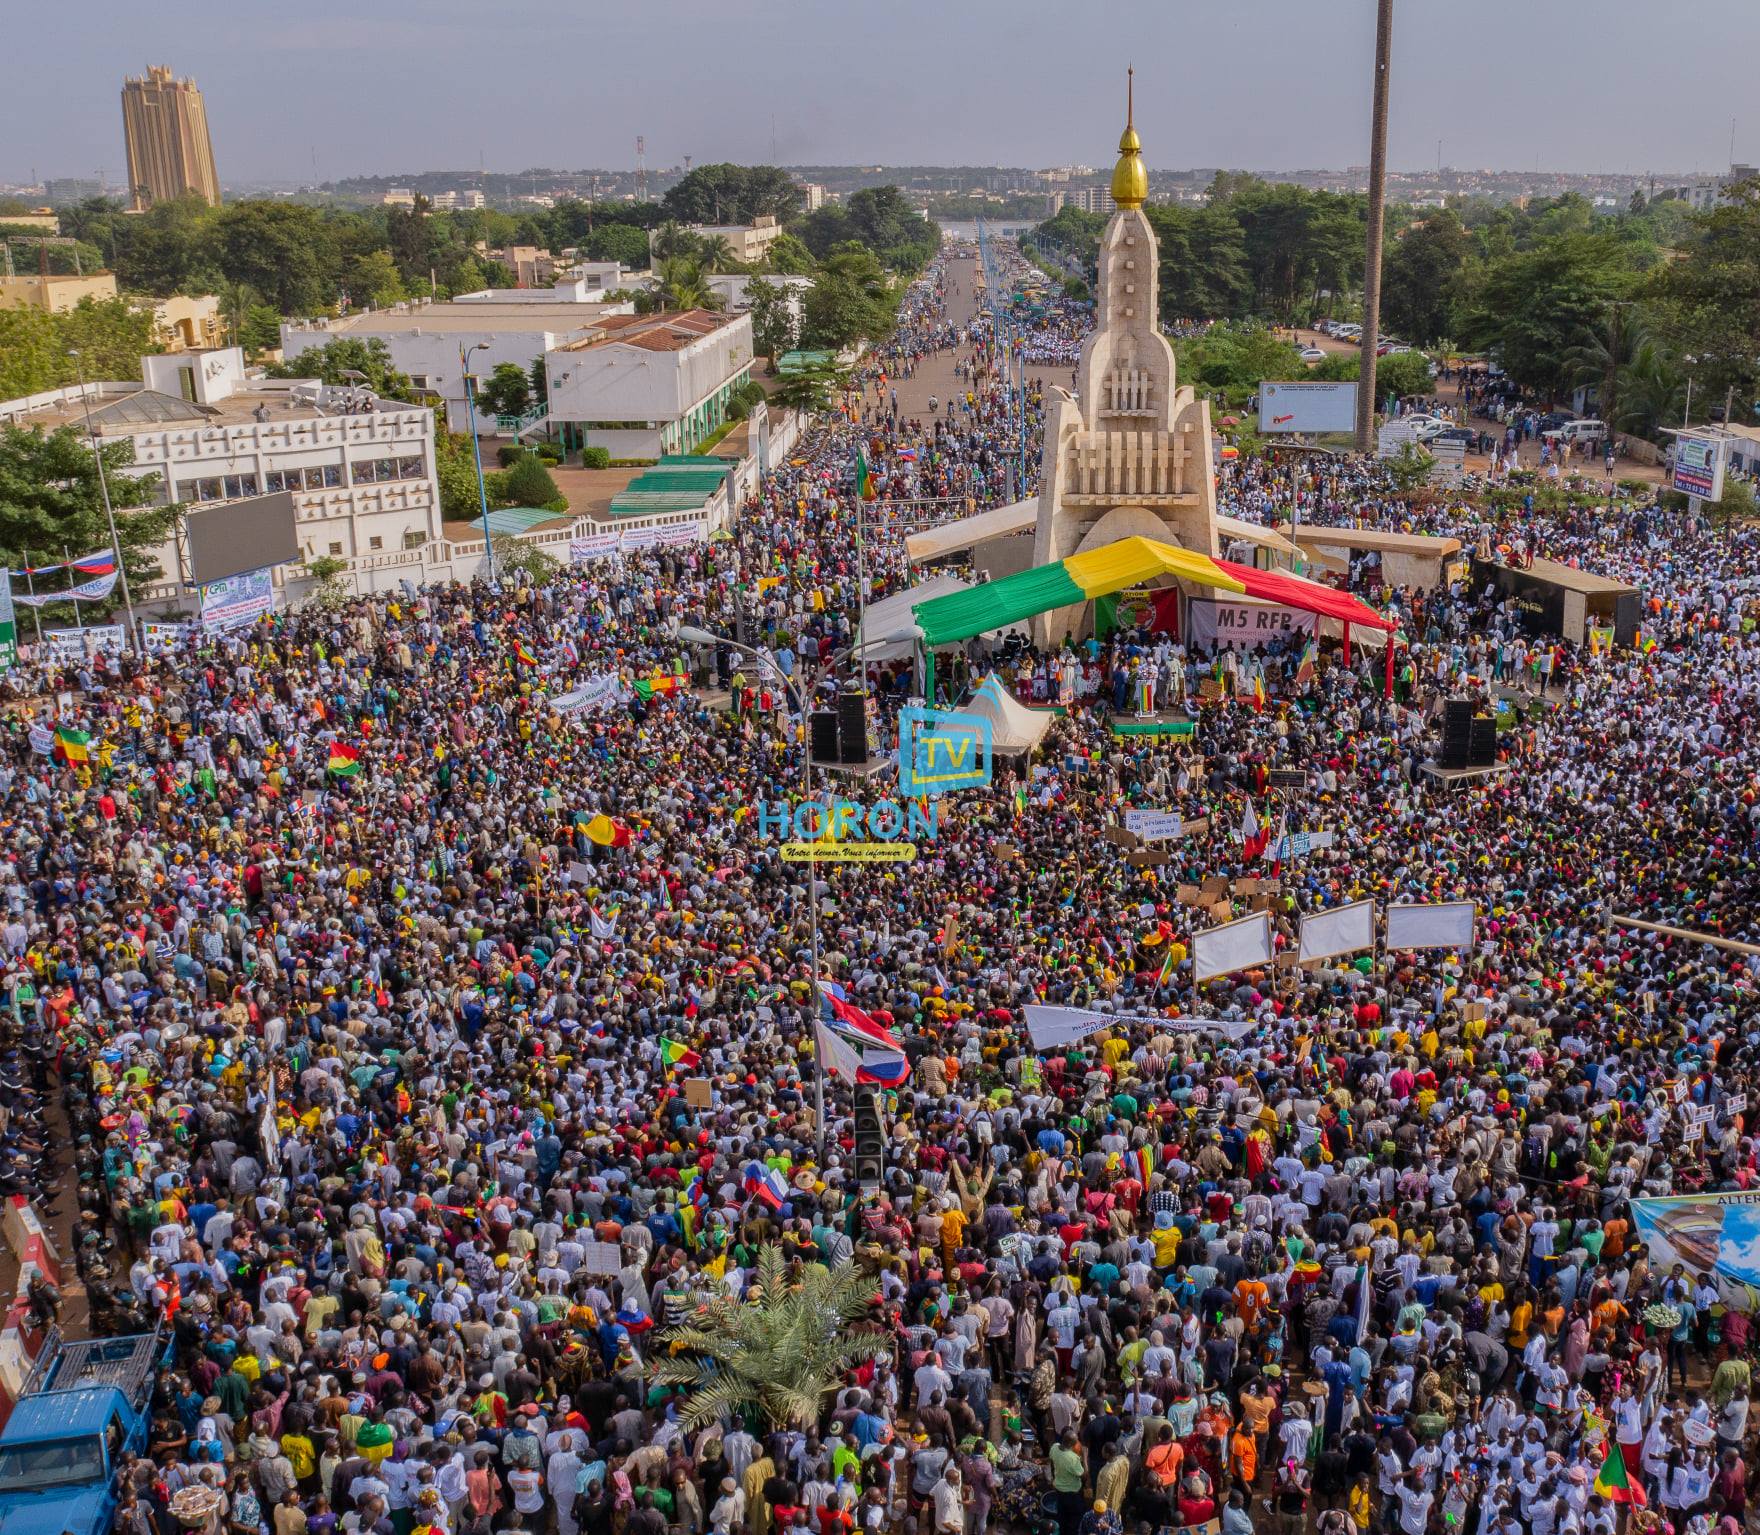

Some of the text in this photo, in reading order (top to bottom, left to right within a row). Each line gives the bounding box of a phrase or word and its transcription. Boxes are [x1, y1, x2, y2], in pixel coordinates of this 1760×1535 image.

[1217, 608, 1292, 630] M5 RFP
[1247, 1293, 1255, 1307] 8
